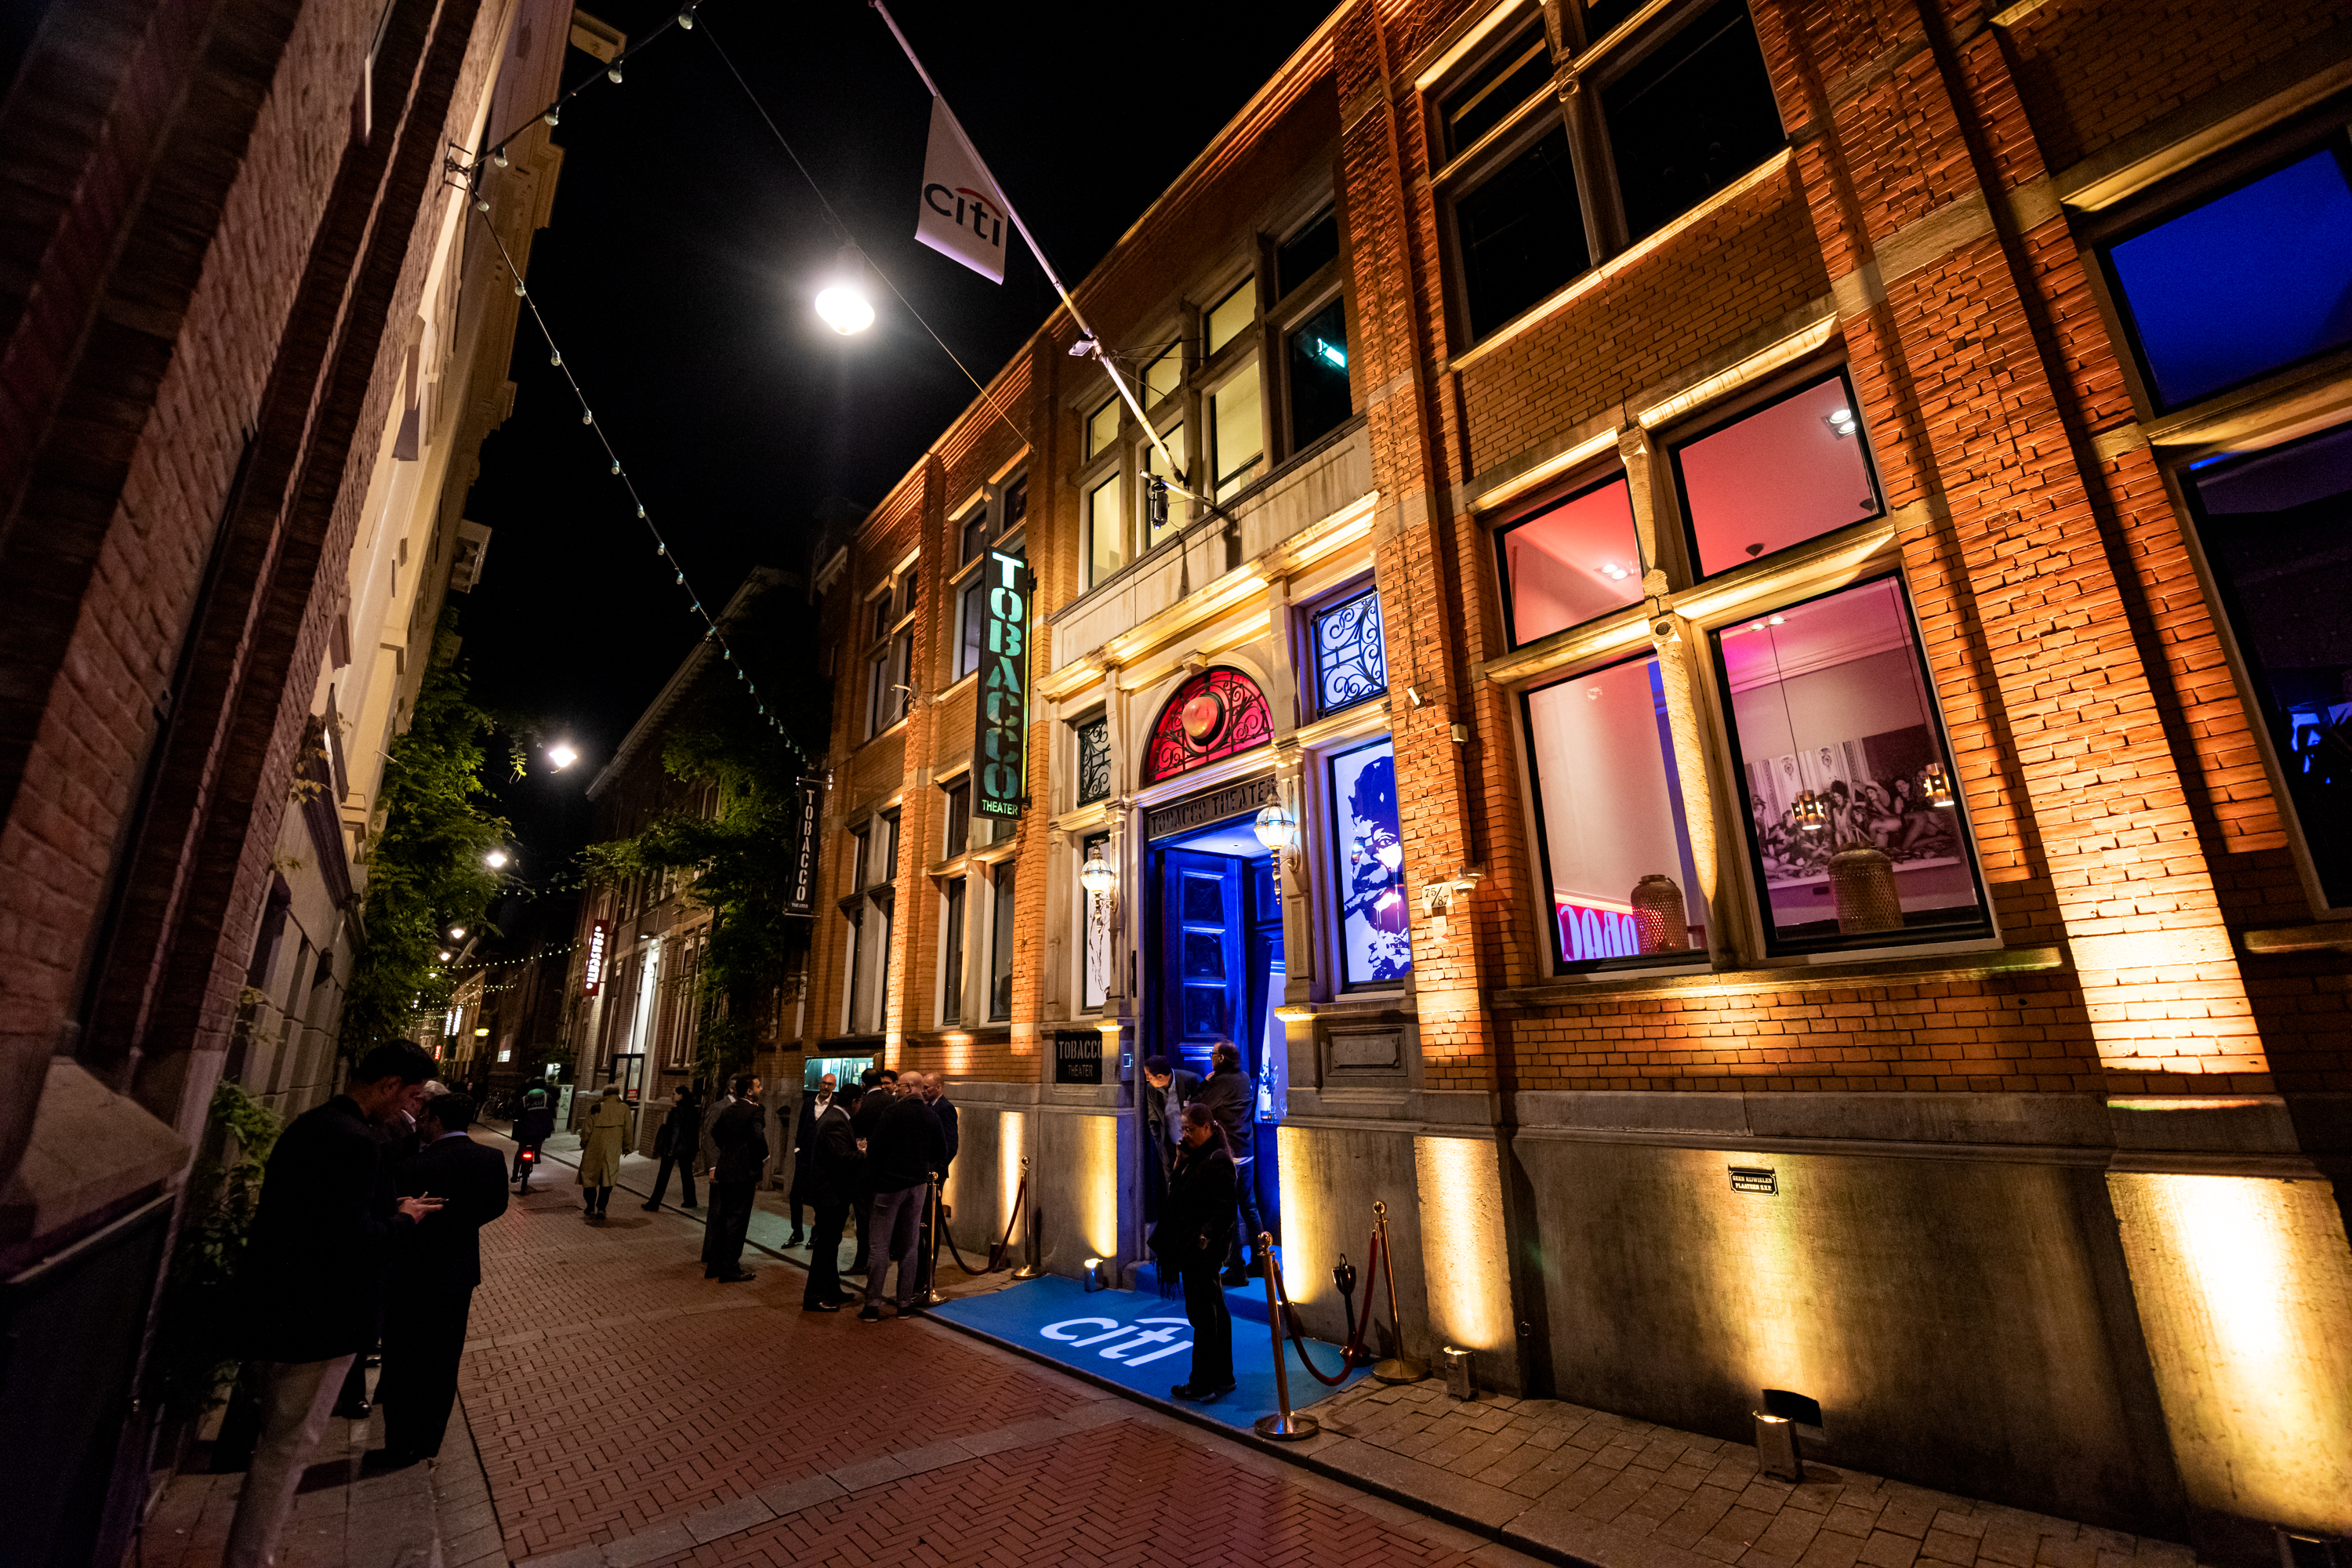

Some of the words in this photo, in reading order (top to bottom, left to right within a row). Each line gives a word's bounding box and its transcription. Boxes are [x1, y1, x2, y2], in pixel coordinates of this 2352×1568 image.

[924, 183, 1004, 248] citi
[982, 551, 1025, 800] TOBACCO
[982, 799, 1018, 816] THEATER
[1151, 801, 1206, 834] TOBACCO
[796, 789, 815, 902] TOBACCO
[1058, 1040, 1102, 1060] TOBACCO
[1068, 1064, 1093, 1077] THEATER
[1040, 1317, 1194, 1367] citi
